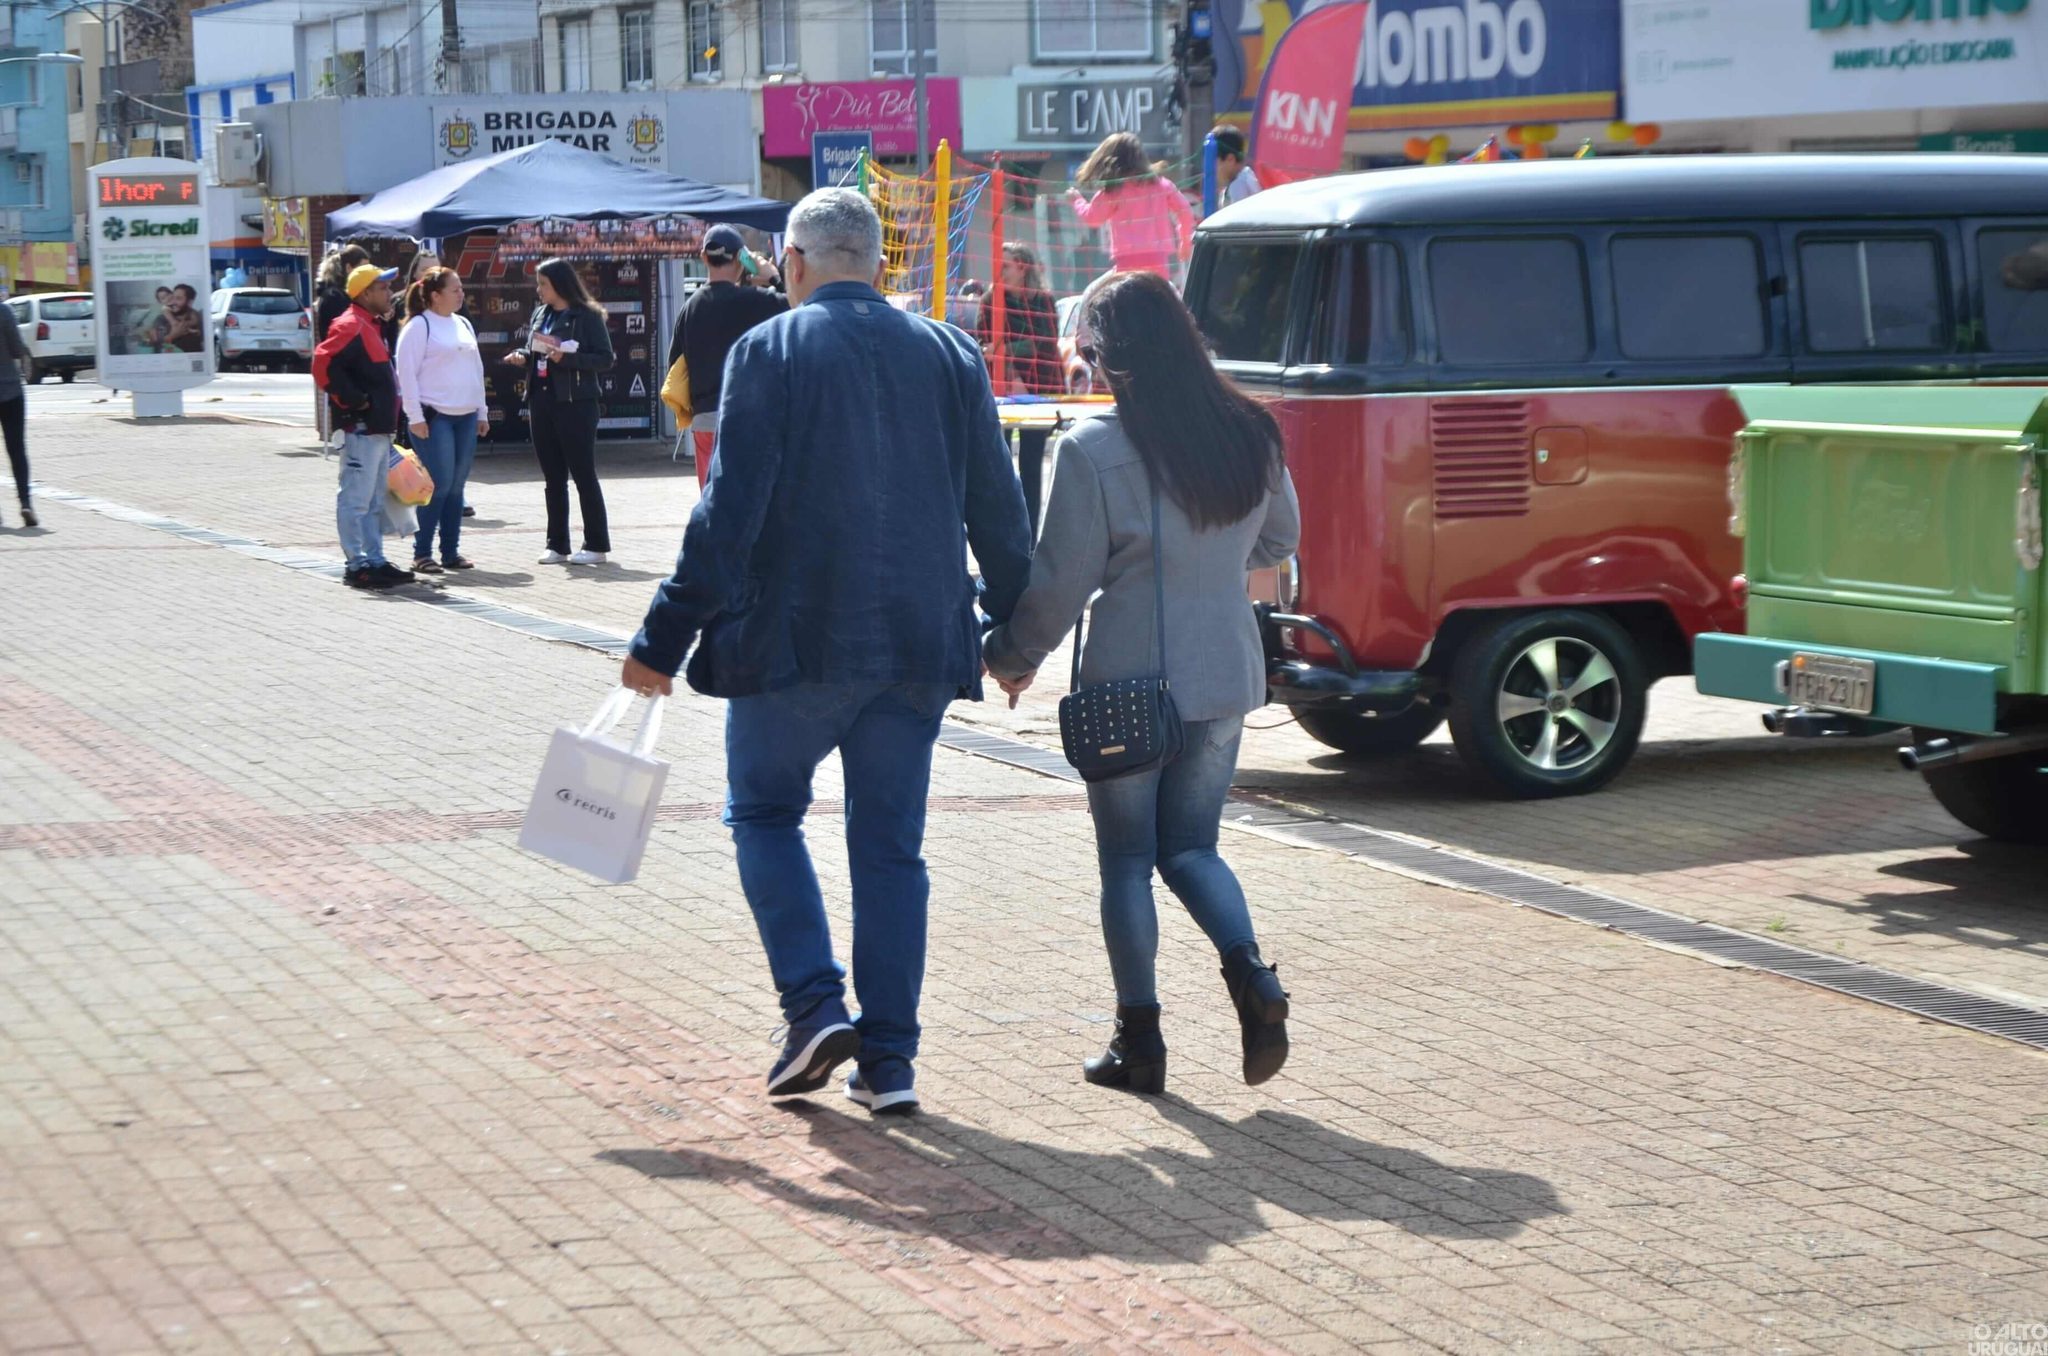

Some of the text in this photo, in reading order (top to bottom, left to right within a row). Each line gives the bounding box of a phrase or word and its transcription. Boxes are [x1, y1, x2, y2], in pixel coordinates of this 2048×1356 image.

[1353, 0, 1547, 88] lombo
[484, 110, 617, 131] BRIGADA
[1027, 87, 1154, 135] LE CAMP
[1265, 89, 1338, 138] KNN
[129, 218, 199, 237] Sicredi
